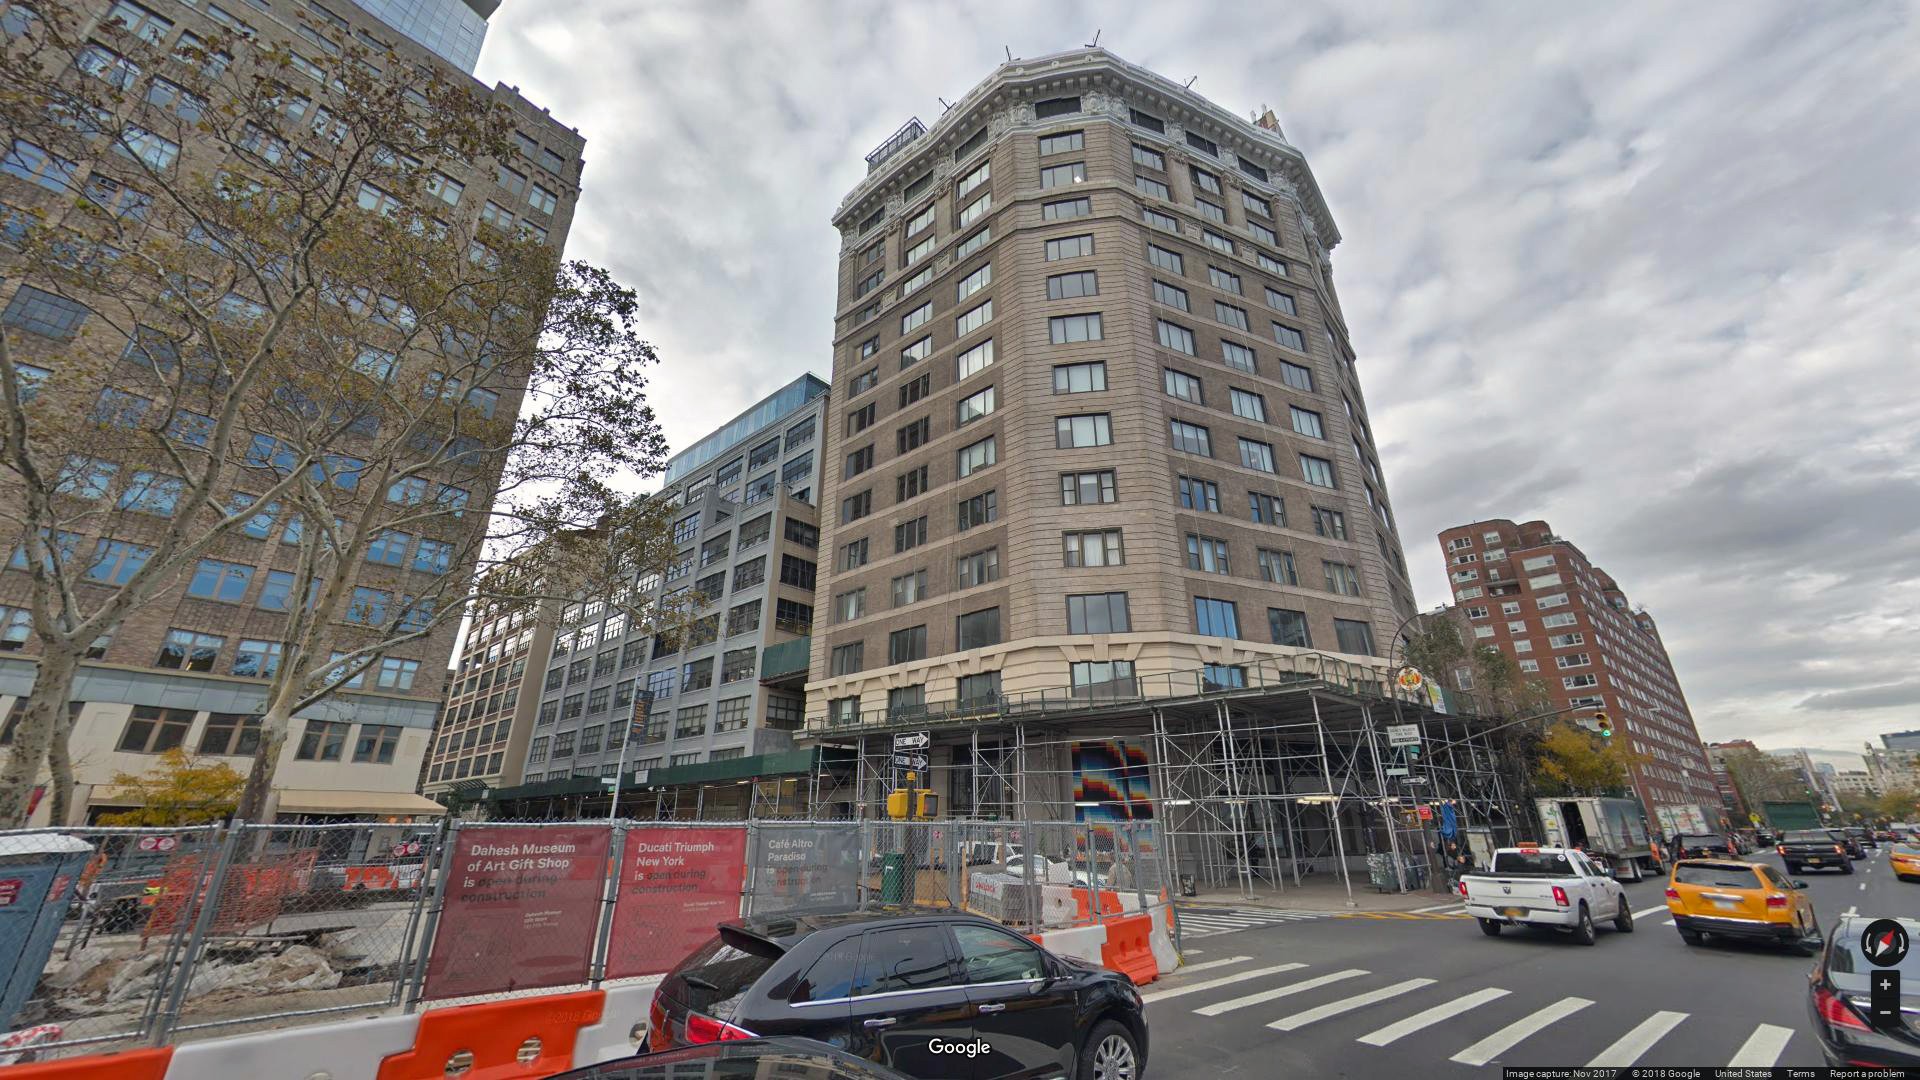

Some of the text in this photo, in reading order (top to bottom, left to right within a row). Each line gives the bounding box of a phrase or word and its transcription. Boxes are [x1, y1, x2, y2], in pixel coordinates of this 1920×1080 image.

[896, 736, 924, 745] ONE WAY
[638, 841, 715, 853] Ducati Triumph
[768, 838, 814, 849] Café Altro
[471, 843, 576, 857] Dahesh Museum
[636, 855, 685, 867] New York
[767, 851, 807, 862] Paradiso
[467, 857, 570, 872] of Art Gift Shop
[634, 868, 706, 881] is open during
[463, 876, 475, 888] is
[478, 876, 512, 889] open
[631, 883, 698, 895] construction
[461, 890, 546, 902] construction
